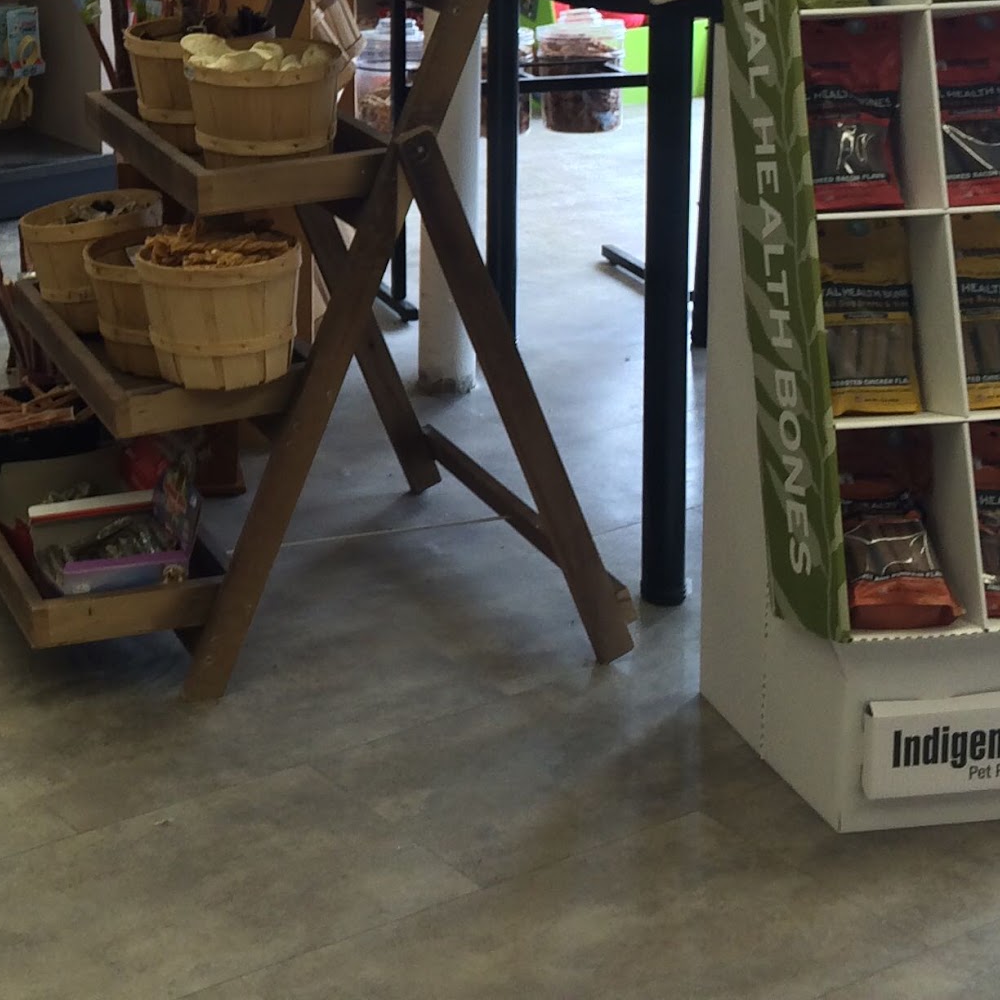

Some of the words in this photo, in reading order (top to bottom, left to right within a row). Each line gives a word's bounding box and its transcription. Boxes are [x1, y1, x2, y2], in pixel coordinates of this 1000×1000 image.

[961, 282, 1000, 295] HEALT
[752, 115, 793, 349] HEALTH
[773, 369, 812, 577] BONES
[892, 726, 1000, 769] Indigen
[968, 765, 992, 780] Pet
